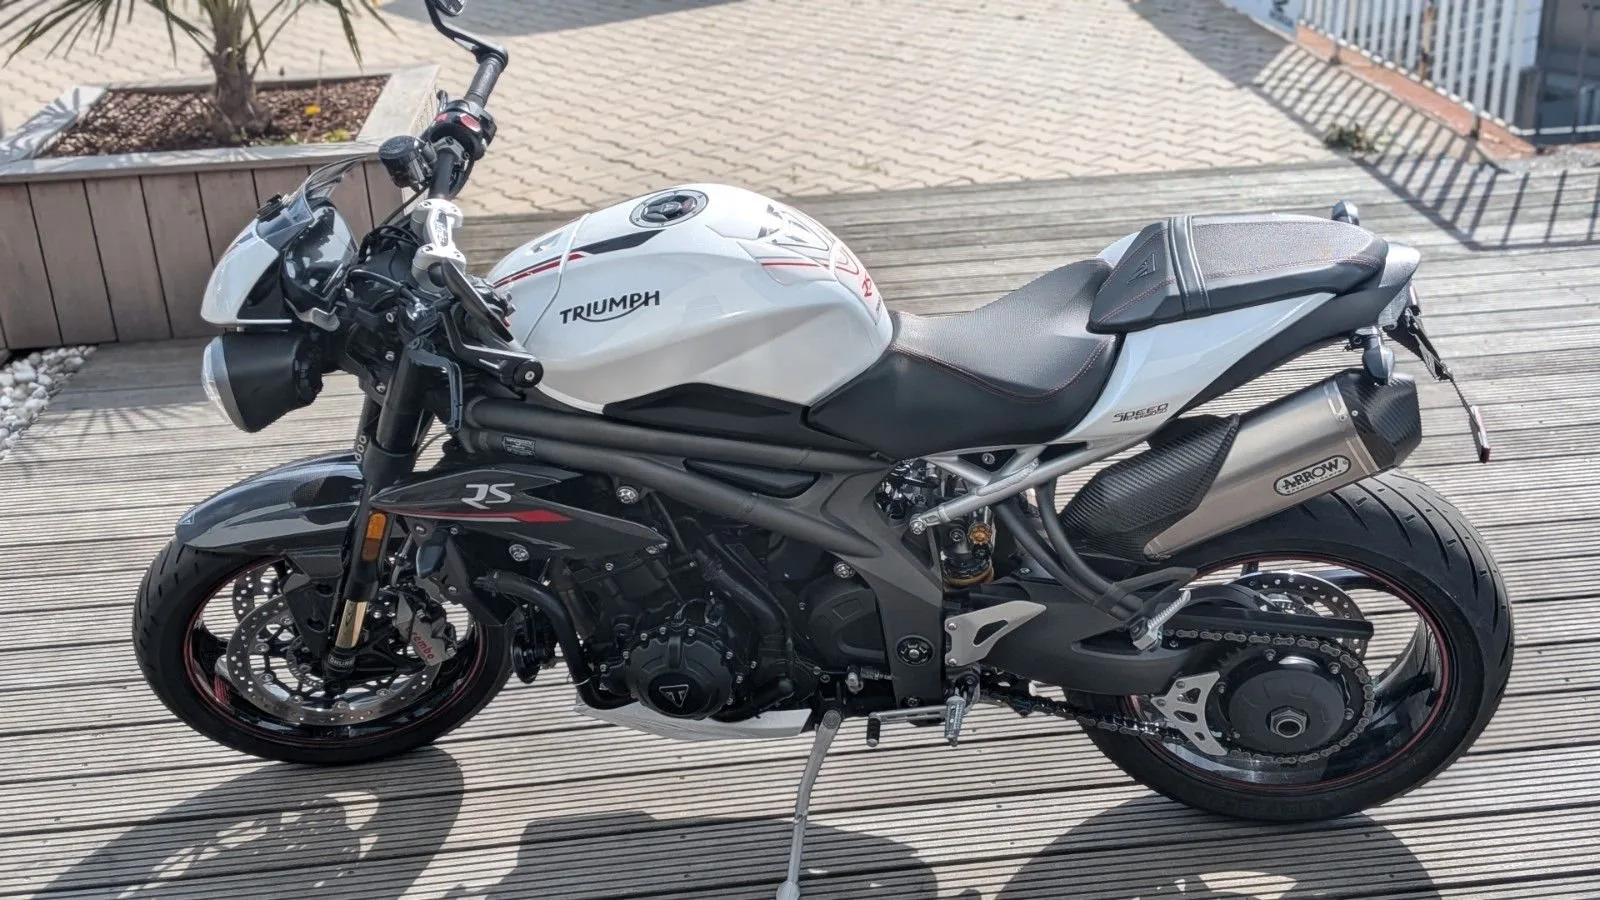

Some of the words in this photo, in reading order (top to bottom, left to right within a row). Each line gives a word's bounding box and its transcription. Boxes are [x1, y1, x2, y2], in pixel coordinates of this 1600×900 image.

[560, 290, 660, 324] TRIUMPH
[1282, 458, 1339, 490] ARROW
[461, 482, 516, 510] RS
[411, 631, 435, 659] rembo
